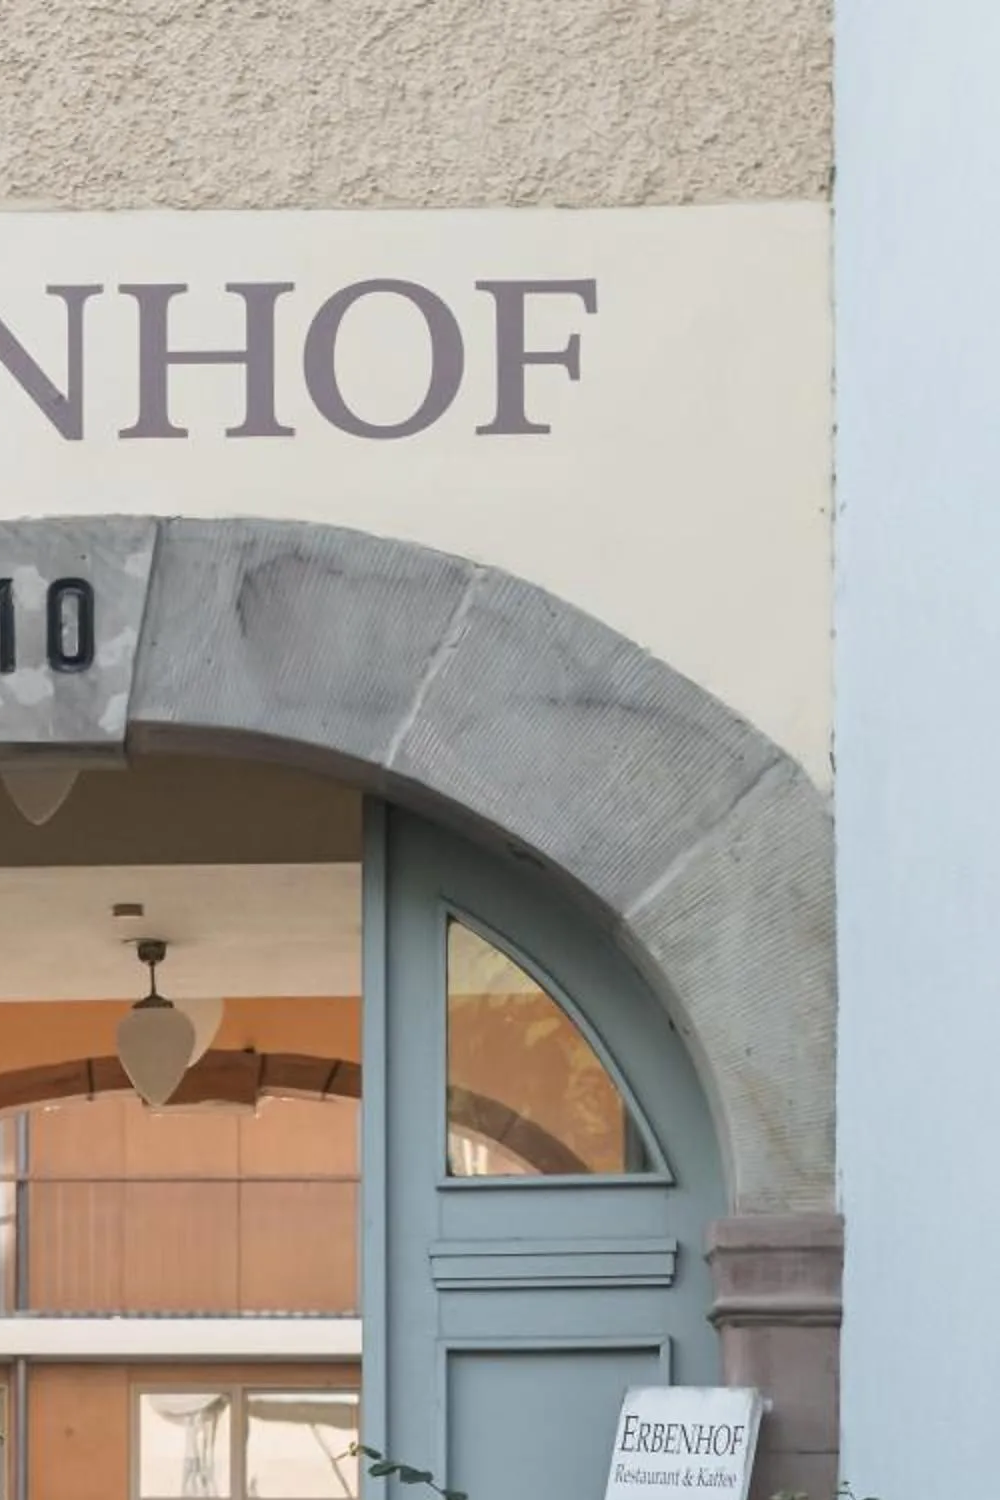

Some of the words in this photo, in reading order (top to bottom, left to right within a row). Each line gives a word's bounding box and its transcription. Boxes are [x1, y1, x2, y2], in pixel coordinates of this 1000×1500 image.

[618, 1415, 745, 1457] ERBENHOF
[614, 1463, 680, 1487] Restaurant
[682, 1468, 693, 1487] &
[696, 1467, 738, 1489] Kaffee
